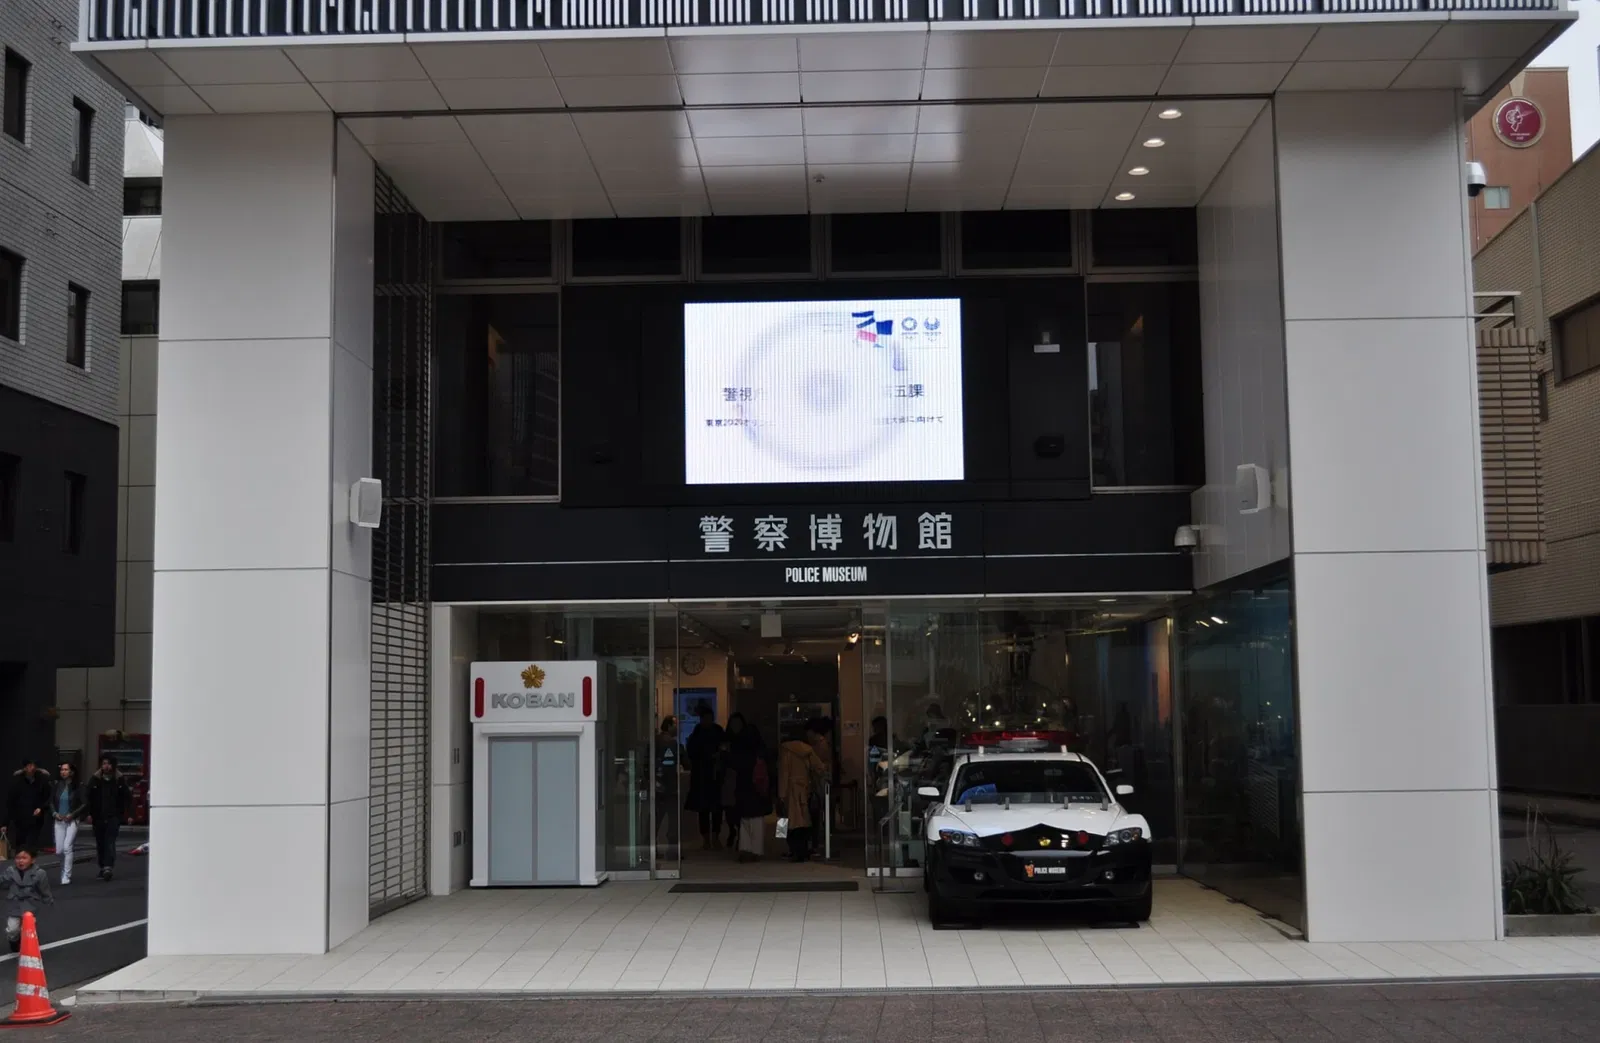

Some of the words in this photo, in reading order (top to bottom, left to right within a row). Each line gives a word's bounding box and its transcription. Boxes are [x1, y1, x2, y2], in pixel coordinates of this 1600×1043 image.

[698, 512, 953, 553] 警察博物館
[785, 566, 820, 583] POLICE
[822, 566, 867, 582] MUSEUM
[491, 692, 575, 709] KOBAN
